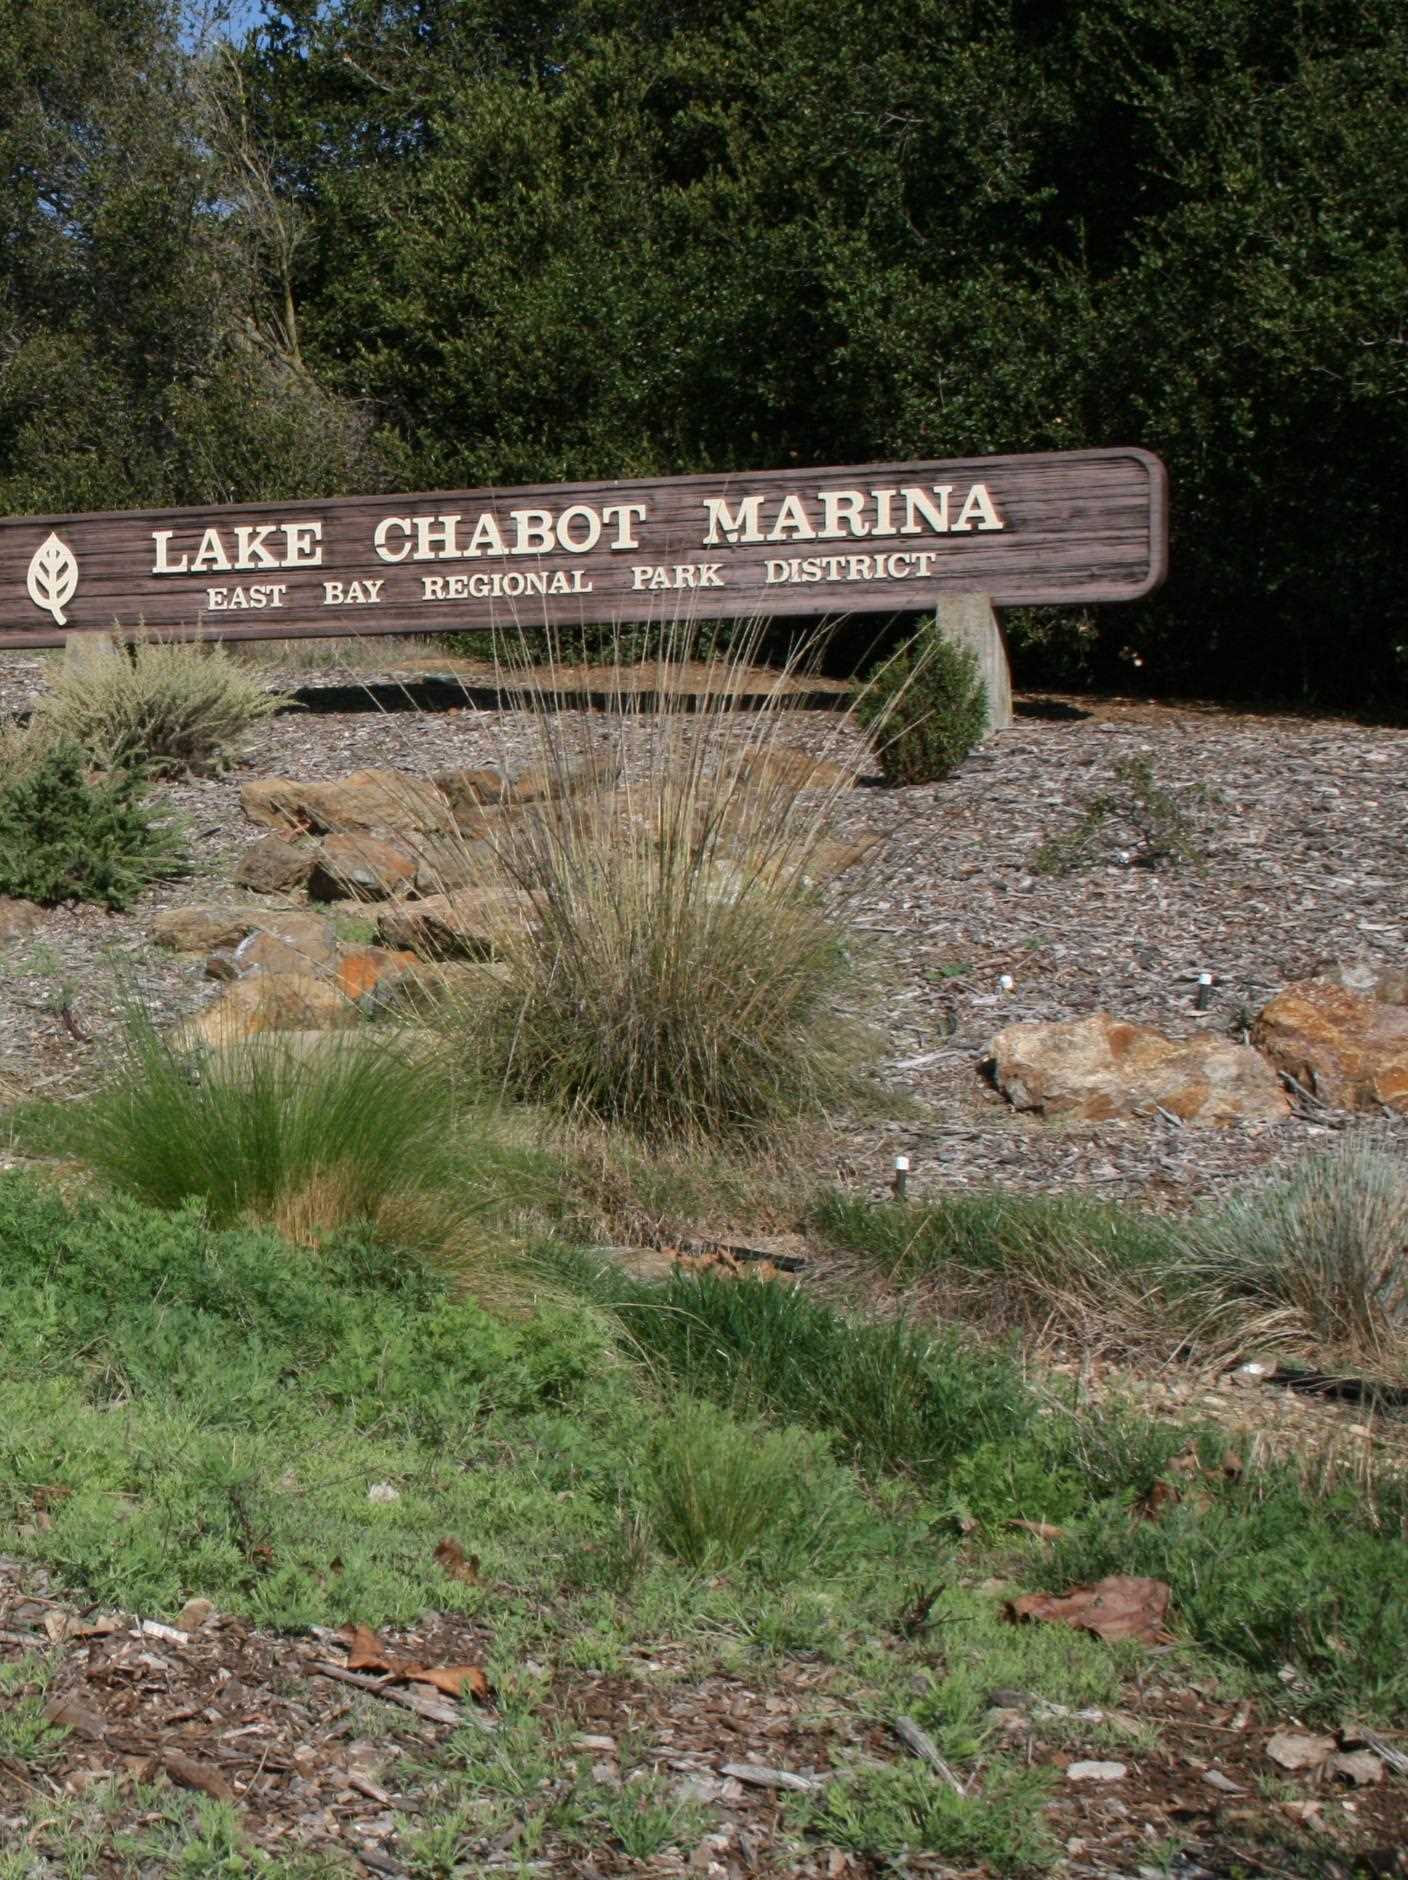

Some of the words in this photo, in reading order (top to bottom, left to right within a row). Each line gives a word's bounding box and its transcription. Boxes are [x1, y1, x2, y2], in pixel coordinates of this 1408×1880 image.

[152, 522, 323, 574] LAKE
[374, 504, 646, 563] CHABOT
[703, 484, 1003, 545] MARINA
[207, 584, 286, 611] EAST
[323, 579, 385, 605] BAY
[421, 570, 592, 600] REGIONAL
[631, 563, 724, 590] PARK
[764, 552, 936, 584] DISTRICT
